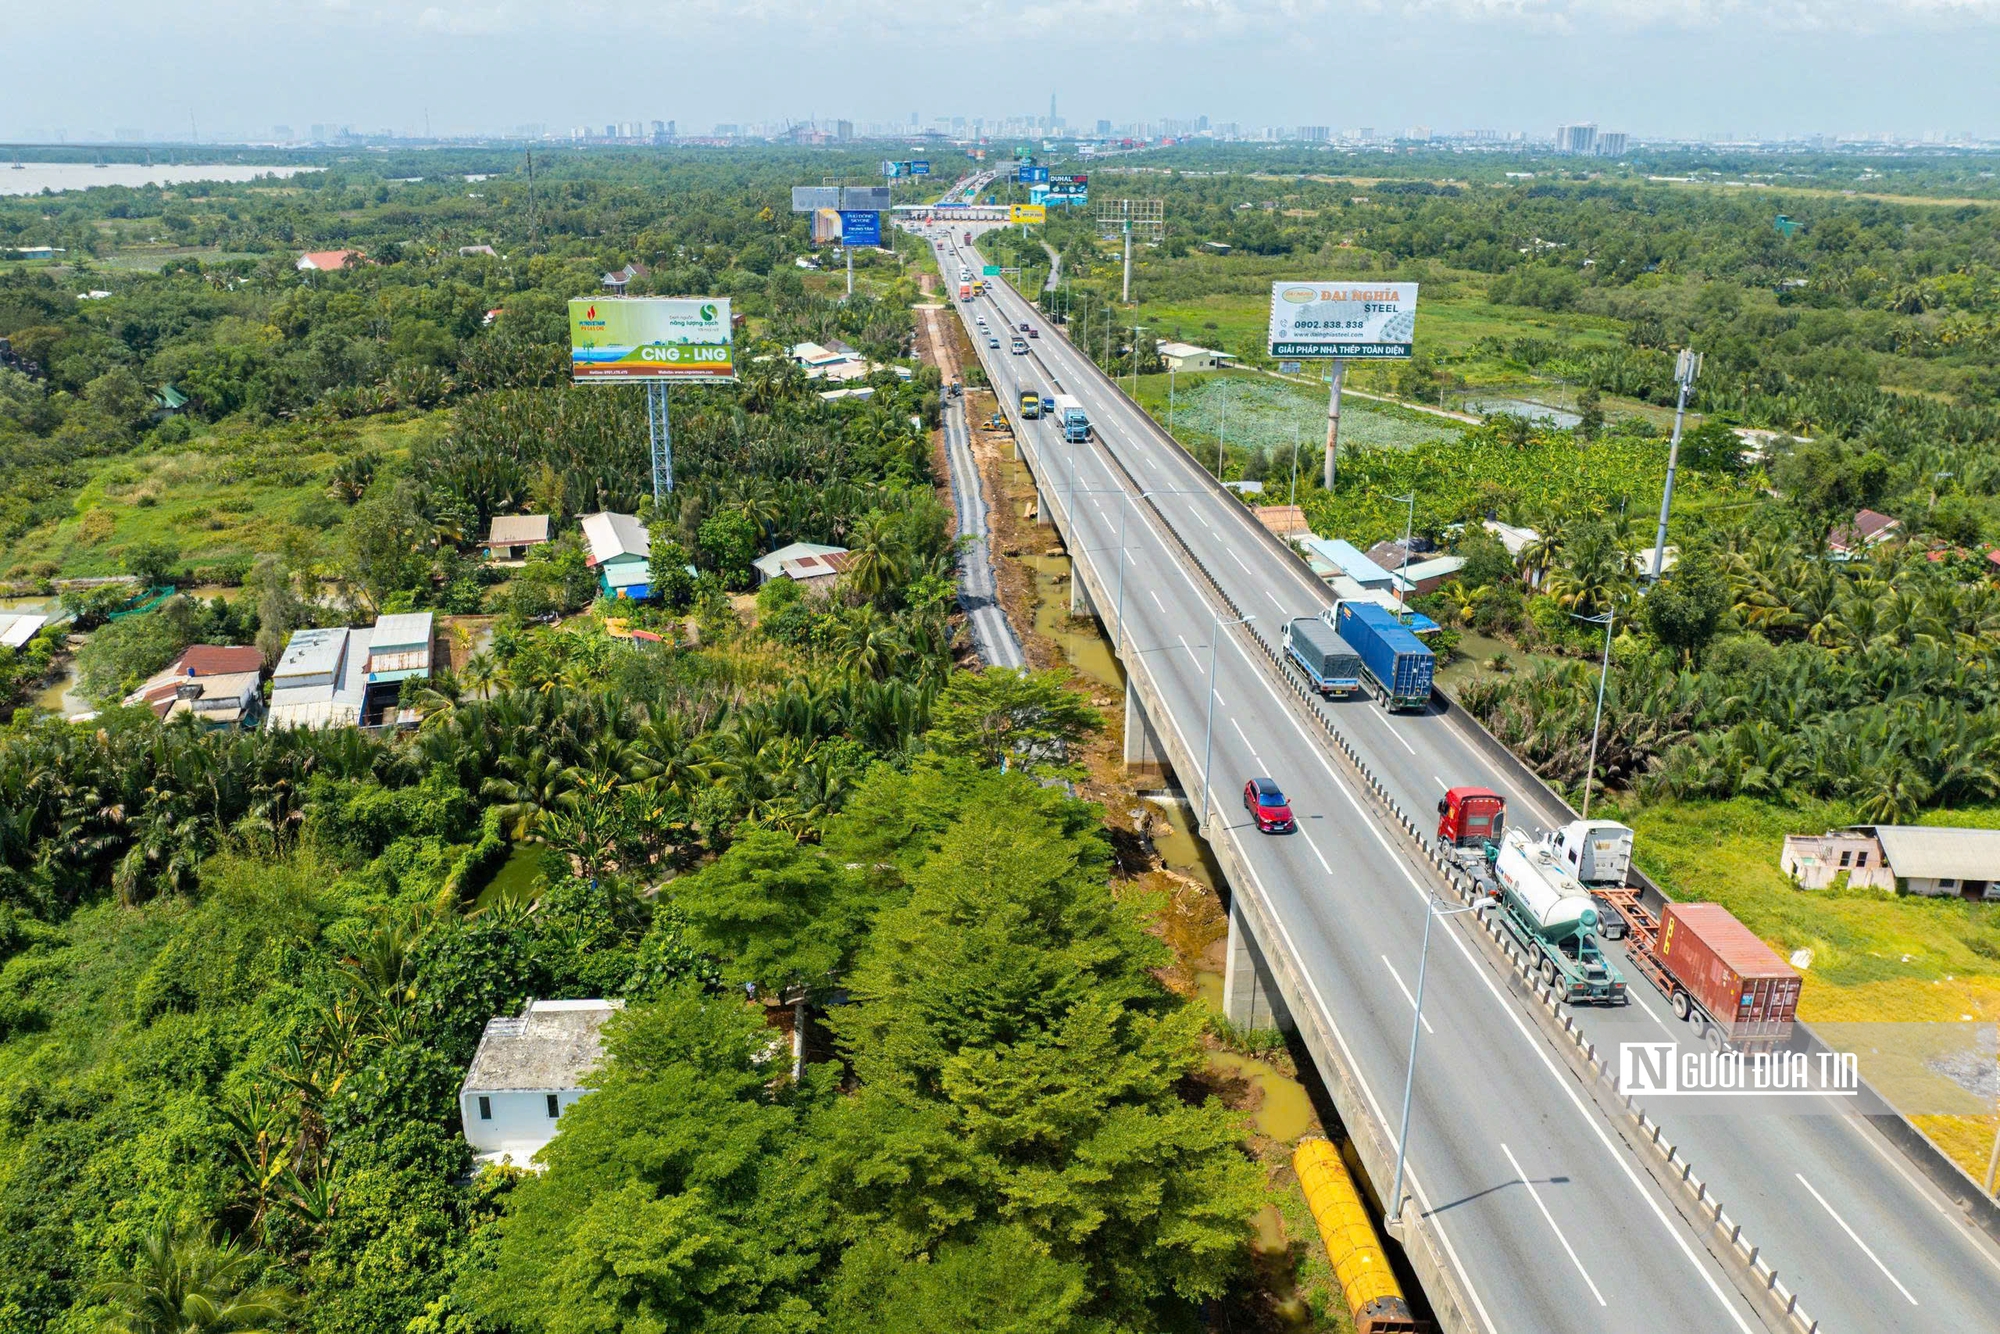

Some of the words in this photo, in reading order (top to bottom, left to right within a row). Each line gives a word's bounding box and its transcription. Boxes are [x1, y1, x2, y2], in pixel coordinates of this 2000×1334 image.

[1321, 290, 1347, 303] ĐẠI
[1351, 287, 1400, 302] NGHĨA
[1364, 304, 1399, 313] STEEL
[1293, 331, 1364, 339] www.dainghiasteel.com
[641, 348, 680, 361] CNG
[694, 348, 727, 361] LNG
[1278, 345, 1296, 354] GIẢI
[1298, 345, 1319, 354] PHÁP
[1320, 345, 1338, 354] NHÀ
[1340, 345, 1361, 354] THÉP
[1363, 345, 1385, 354] TOÀN
[1385, 346, 1405, 356] DIỆN
